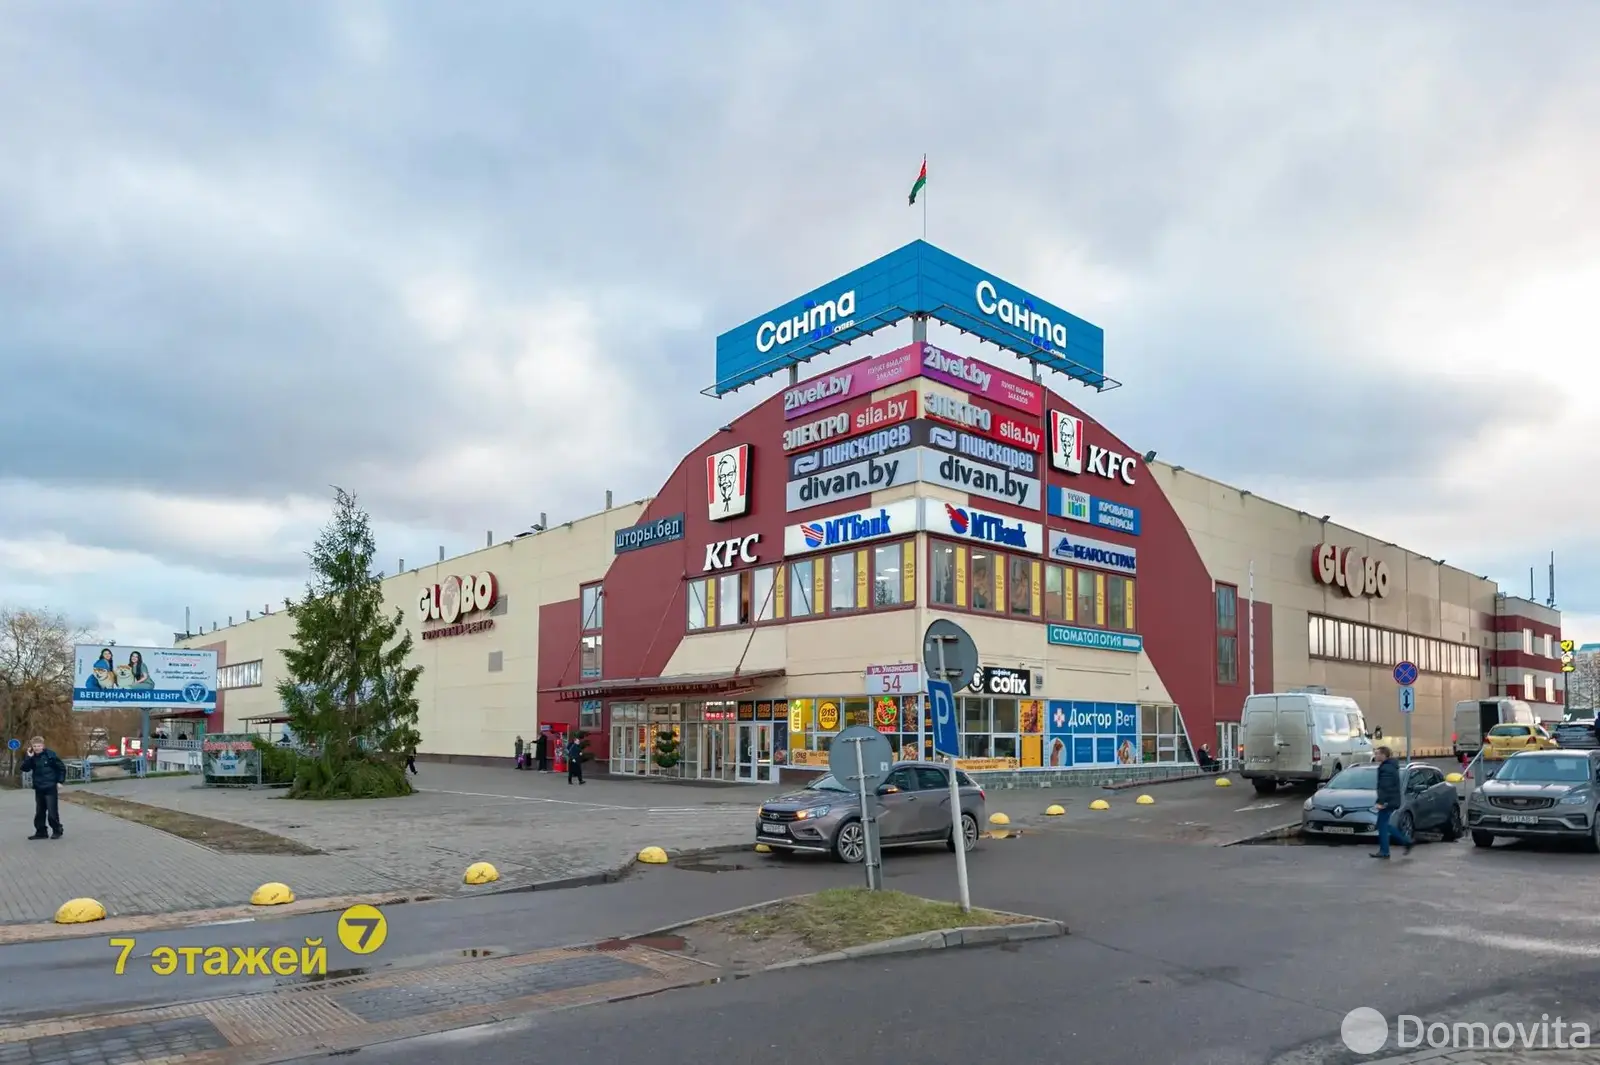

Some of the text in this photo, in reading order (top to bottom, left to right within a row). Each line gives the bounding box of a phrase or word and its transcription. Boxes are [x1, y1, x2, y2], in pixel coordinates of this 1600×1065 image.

[756, 290, 856, 352] Санта
[976, 280, 1066, 348] Санта
[923, 346, 991, 392] 21vek.by
[784, 374, 852, 411] 21vek.by
[924, 392, 991, 430] ЭЛЕКТРО
[783, 412, 849, 450] ЭЛЕКТРО
[856, 400, 908, 428] sila.by
[1000, 420, 1040, 450] sila.by
[800, 460, 898, 502] divan.by
[940, 455, 1028, 504] divan.by
[1087, 444, 1136, 485] KFC
[1068, 492, 1086, 504] vegas
[1098, 501, 1134, 518] КРОВАТИ
[616, 519, 678, 548] шторы.бел
[1098, 514, 1134, 531] МАТРАСЫ
[703, 534, 760, 572] KFC
[1312, 543, 1390, 598] GLOBO
[418, 571, 498, 623] GLOBO
[1054, 628, 1122, 647] СТОМАТОЛОГИЯ
[80, 691, 180, 700] ВЕТЕРИНАРНЫЙ ЦЕНТР
[882, 675, 902, 692] 54
[990, 673, 1026, 694] cofix
[934, 690, 949, 744] P
[1068, 708, 1135, 728] Доктор Вет
